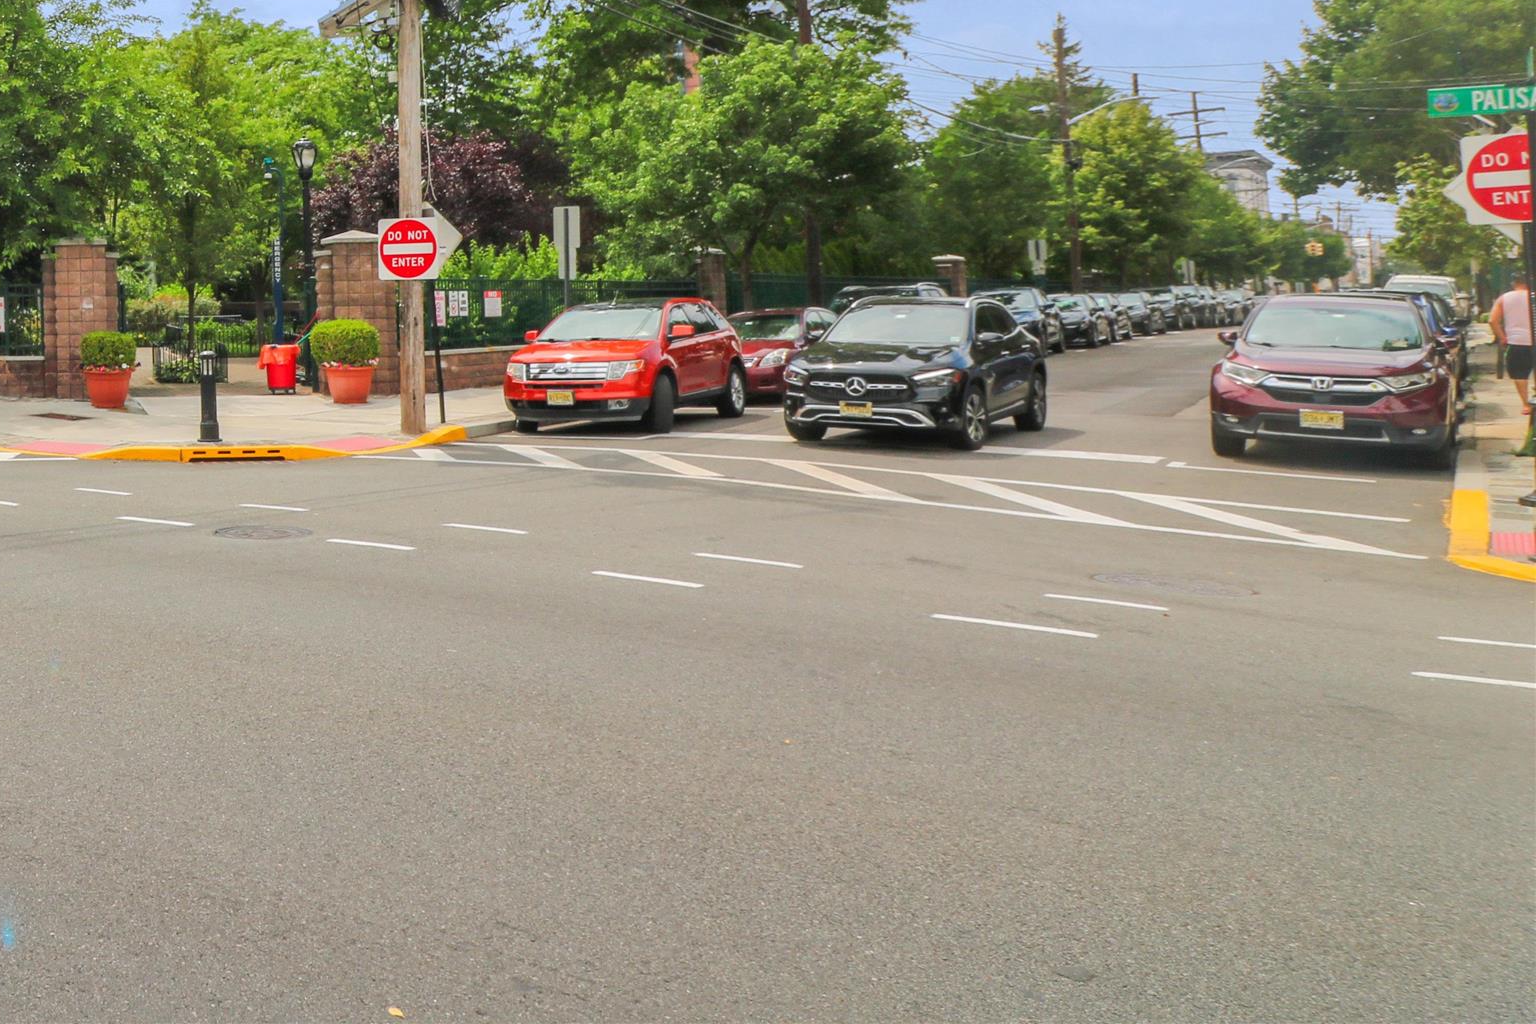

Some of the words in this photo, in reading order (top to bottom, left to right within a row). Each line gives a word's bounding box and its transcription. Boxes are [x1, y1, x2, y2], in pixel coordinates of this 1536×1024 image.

[1480, 152, 1509, 168] DO
[1491, 189, 1531, 206] ENT
[387, 231, 402, 241] DO
[407, 230, 429, 241] NOT
[391, 257, 425, 268] ENTER
